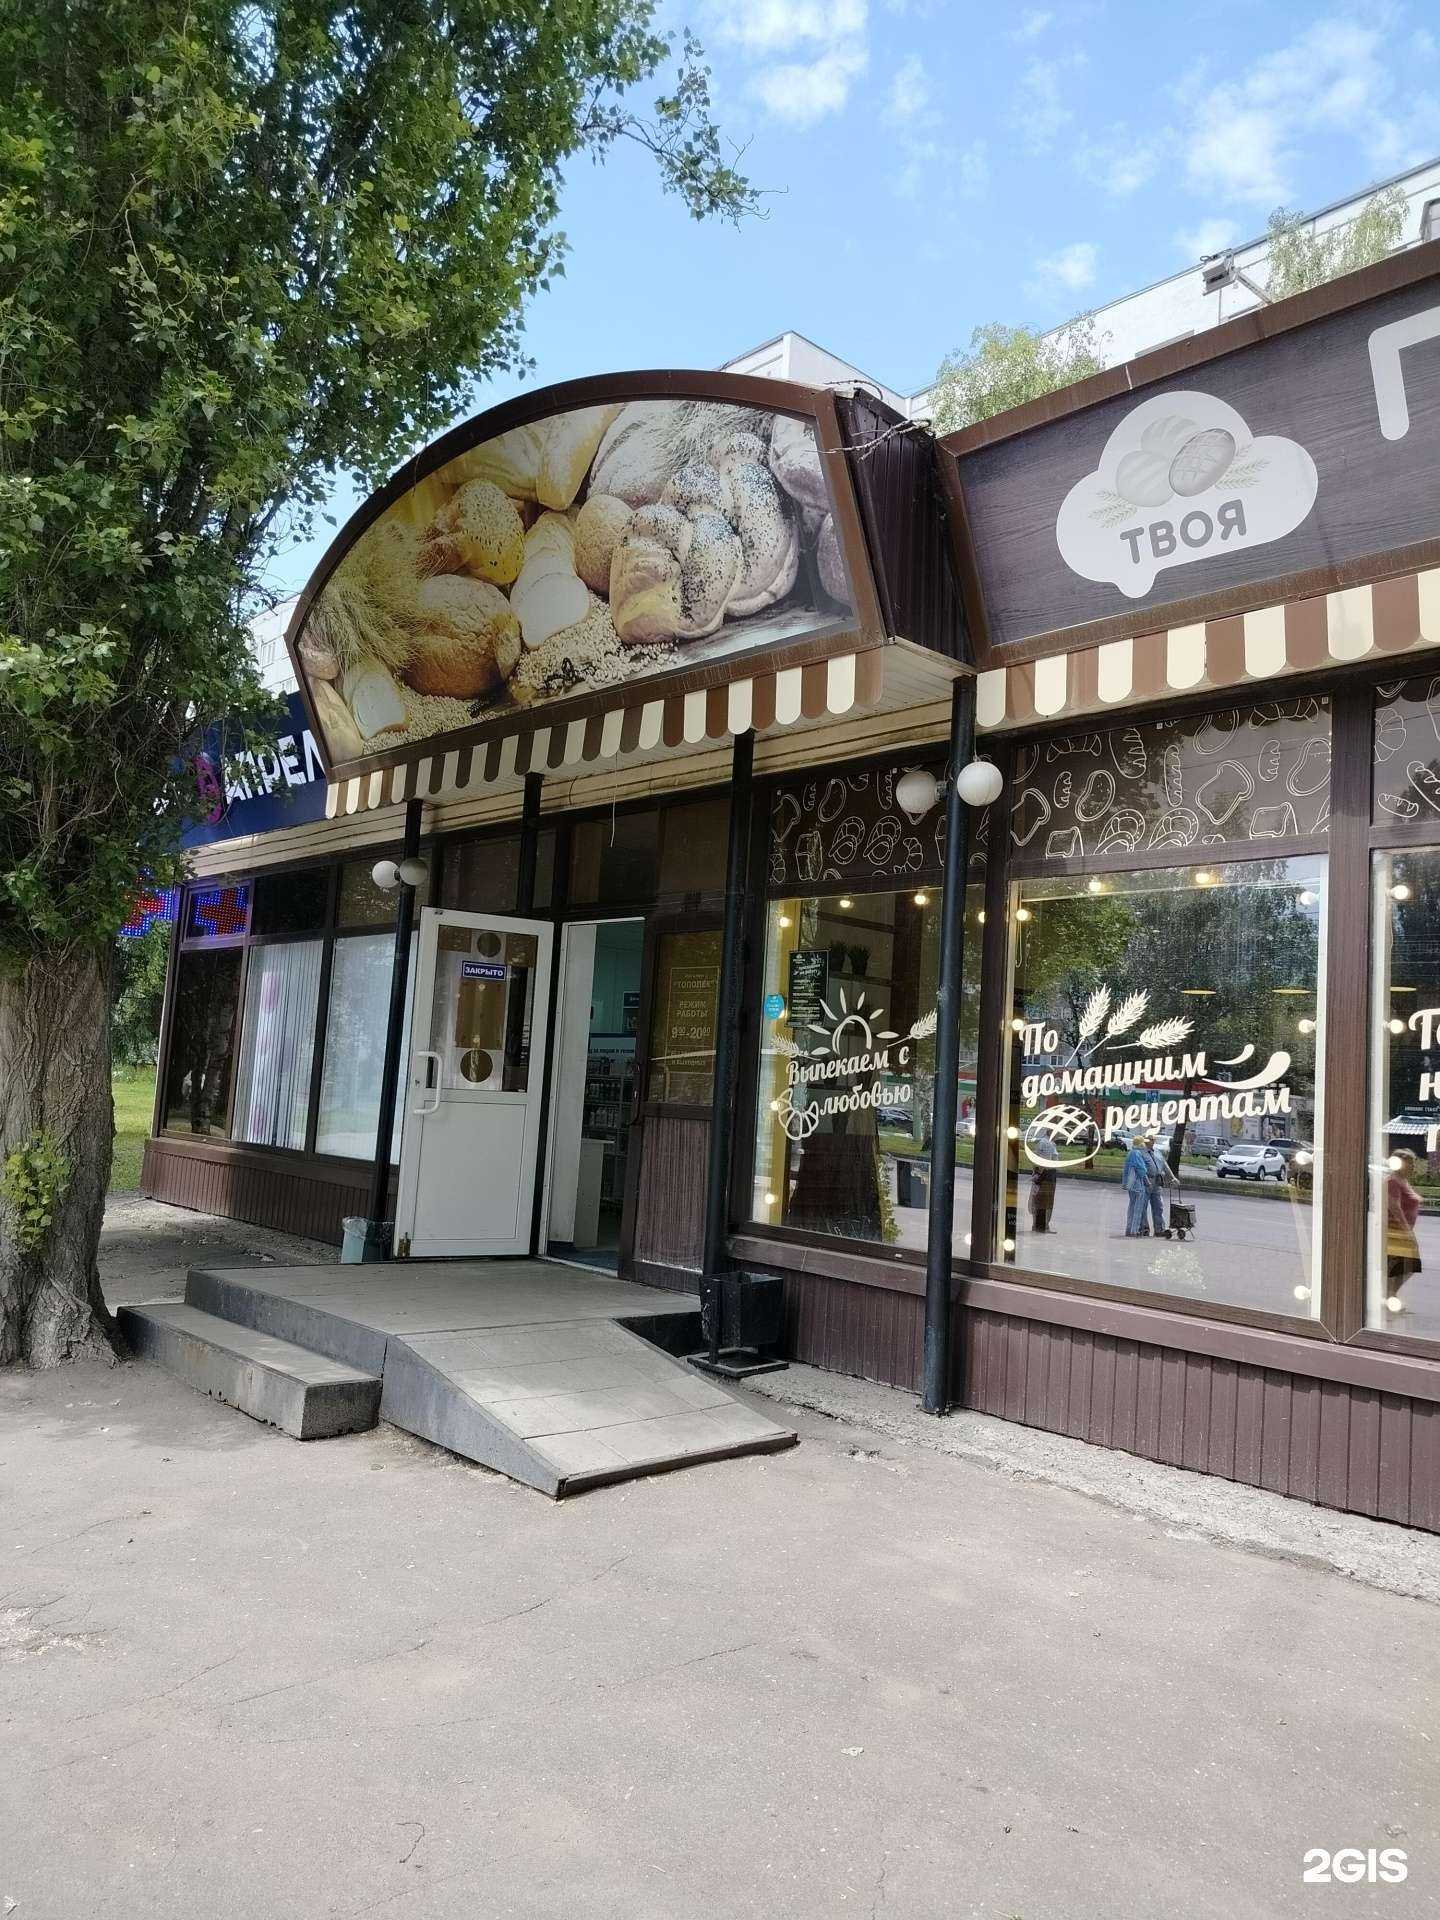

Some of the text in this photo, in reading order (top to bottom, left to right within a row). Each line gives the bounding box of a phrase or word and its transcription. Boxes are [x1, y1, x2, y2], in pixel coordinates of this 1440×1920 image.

[1120, 499, 1247, 565] ТВОЯ
[465, 966, 504, 977] ЗАКРЫТО
[676, 1009, 709, 1018] РАБОТЫ
[679, 1000, 707, 1010] РЕЖИМ
[1019, 1021, 1059, 1056] По
[786, 1046, 911, 1086] Выпекаем с
[1021, 1051, 1208, 1108] домашним
[819, 1081, 911, 1116] любовью
[1104, 1087, 1292, 1142] рецептам
